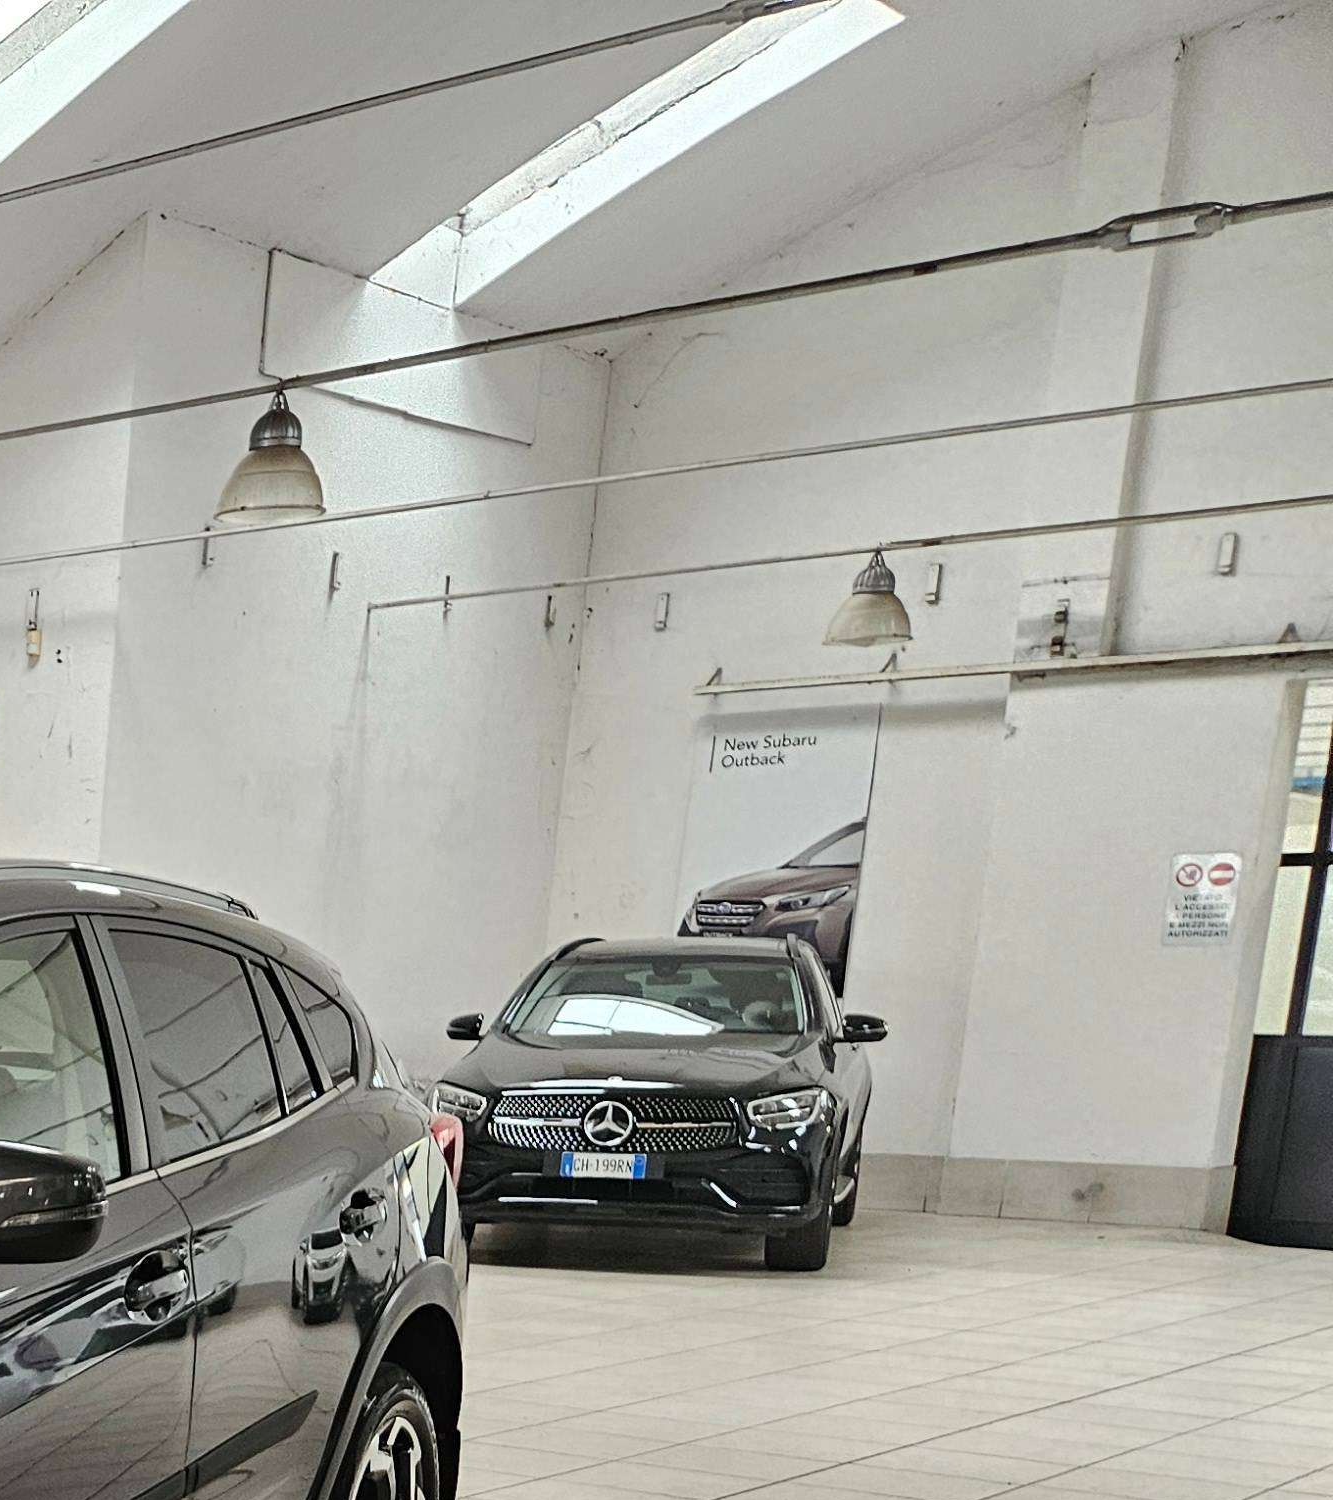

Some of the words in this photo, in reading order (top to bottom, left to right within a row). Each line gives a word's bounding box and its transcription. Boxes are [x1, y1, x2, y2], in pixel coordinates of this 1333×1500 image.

[723, 737, 759, 751] New
[763, 733, 818, 749] Subaru
[720, 751, 785, 768] Outback
